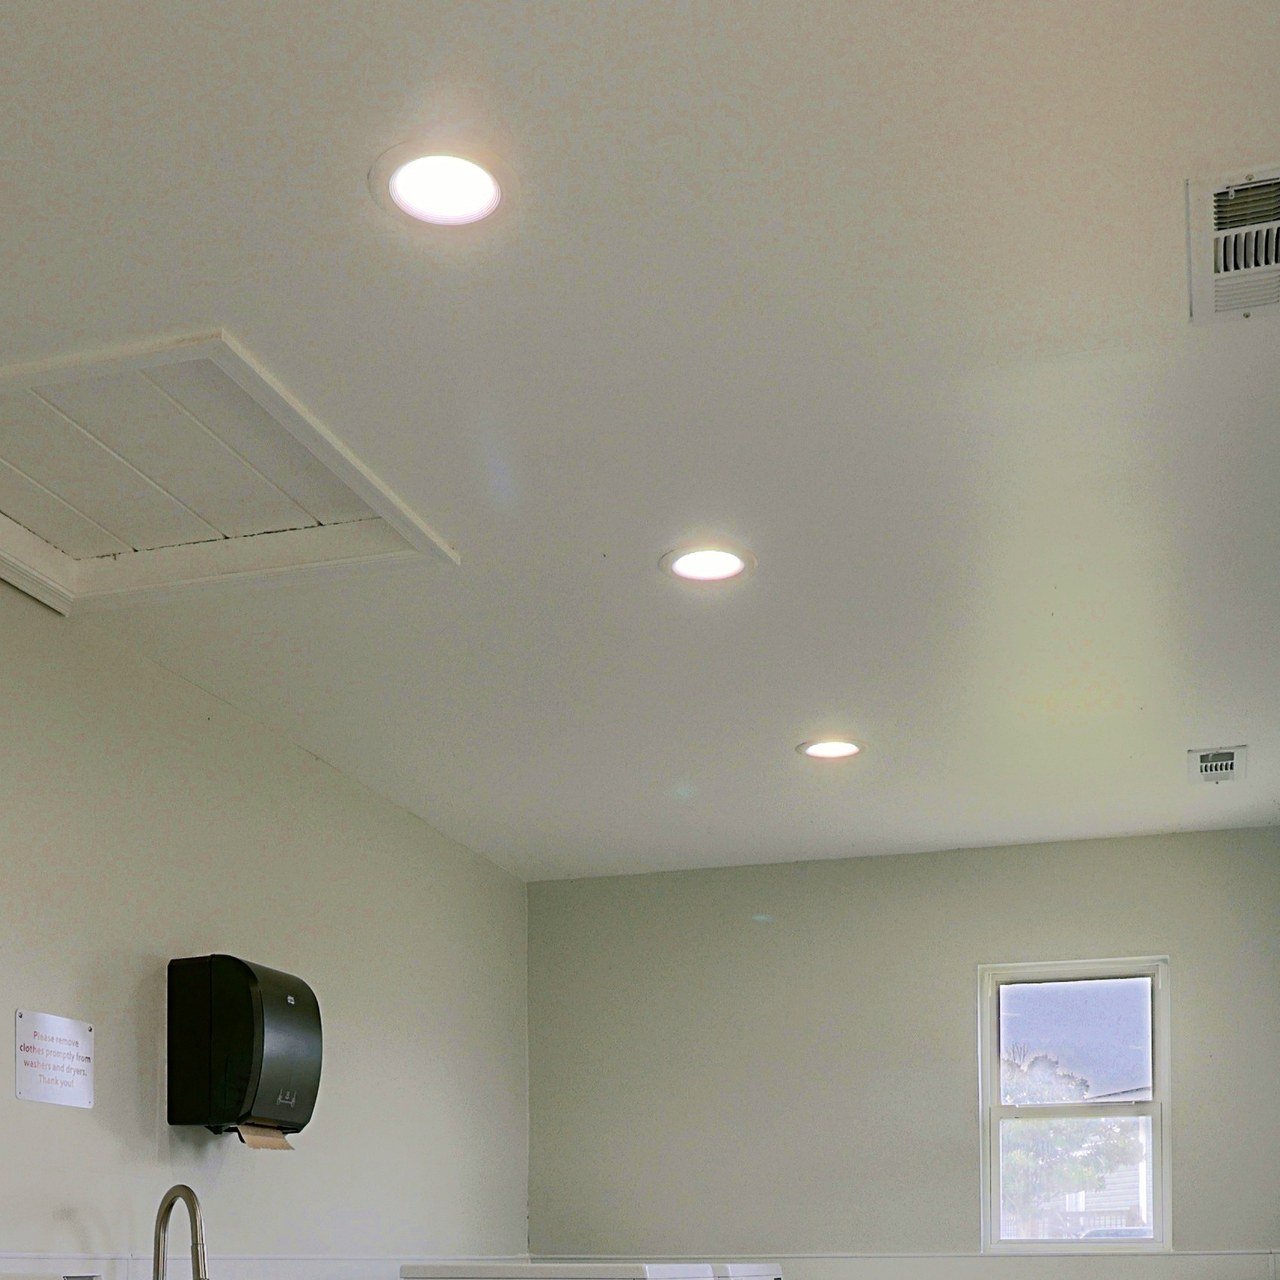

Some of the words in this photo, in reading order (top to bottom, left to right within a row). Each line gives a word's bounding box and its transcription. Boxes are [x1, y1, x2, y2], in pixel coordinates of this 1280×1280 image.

[33, 1030, 54, 1043] Please
[55, 1036, 79, 1048] remove
[19, 1043, 45, 1055] clothes
[45, 1048, 75, 1063] promptly
[76, 1052, 91, 1064] from
[23, 1059, 51, 1071] washers
[52, 1062, 64, 1073] and
[38, 1074, 59, 1086] Thank
[60, 1078, 74, 1088] you!
